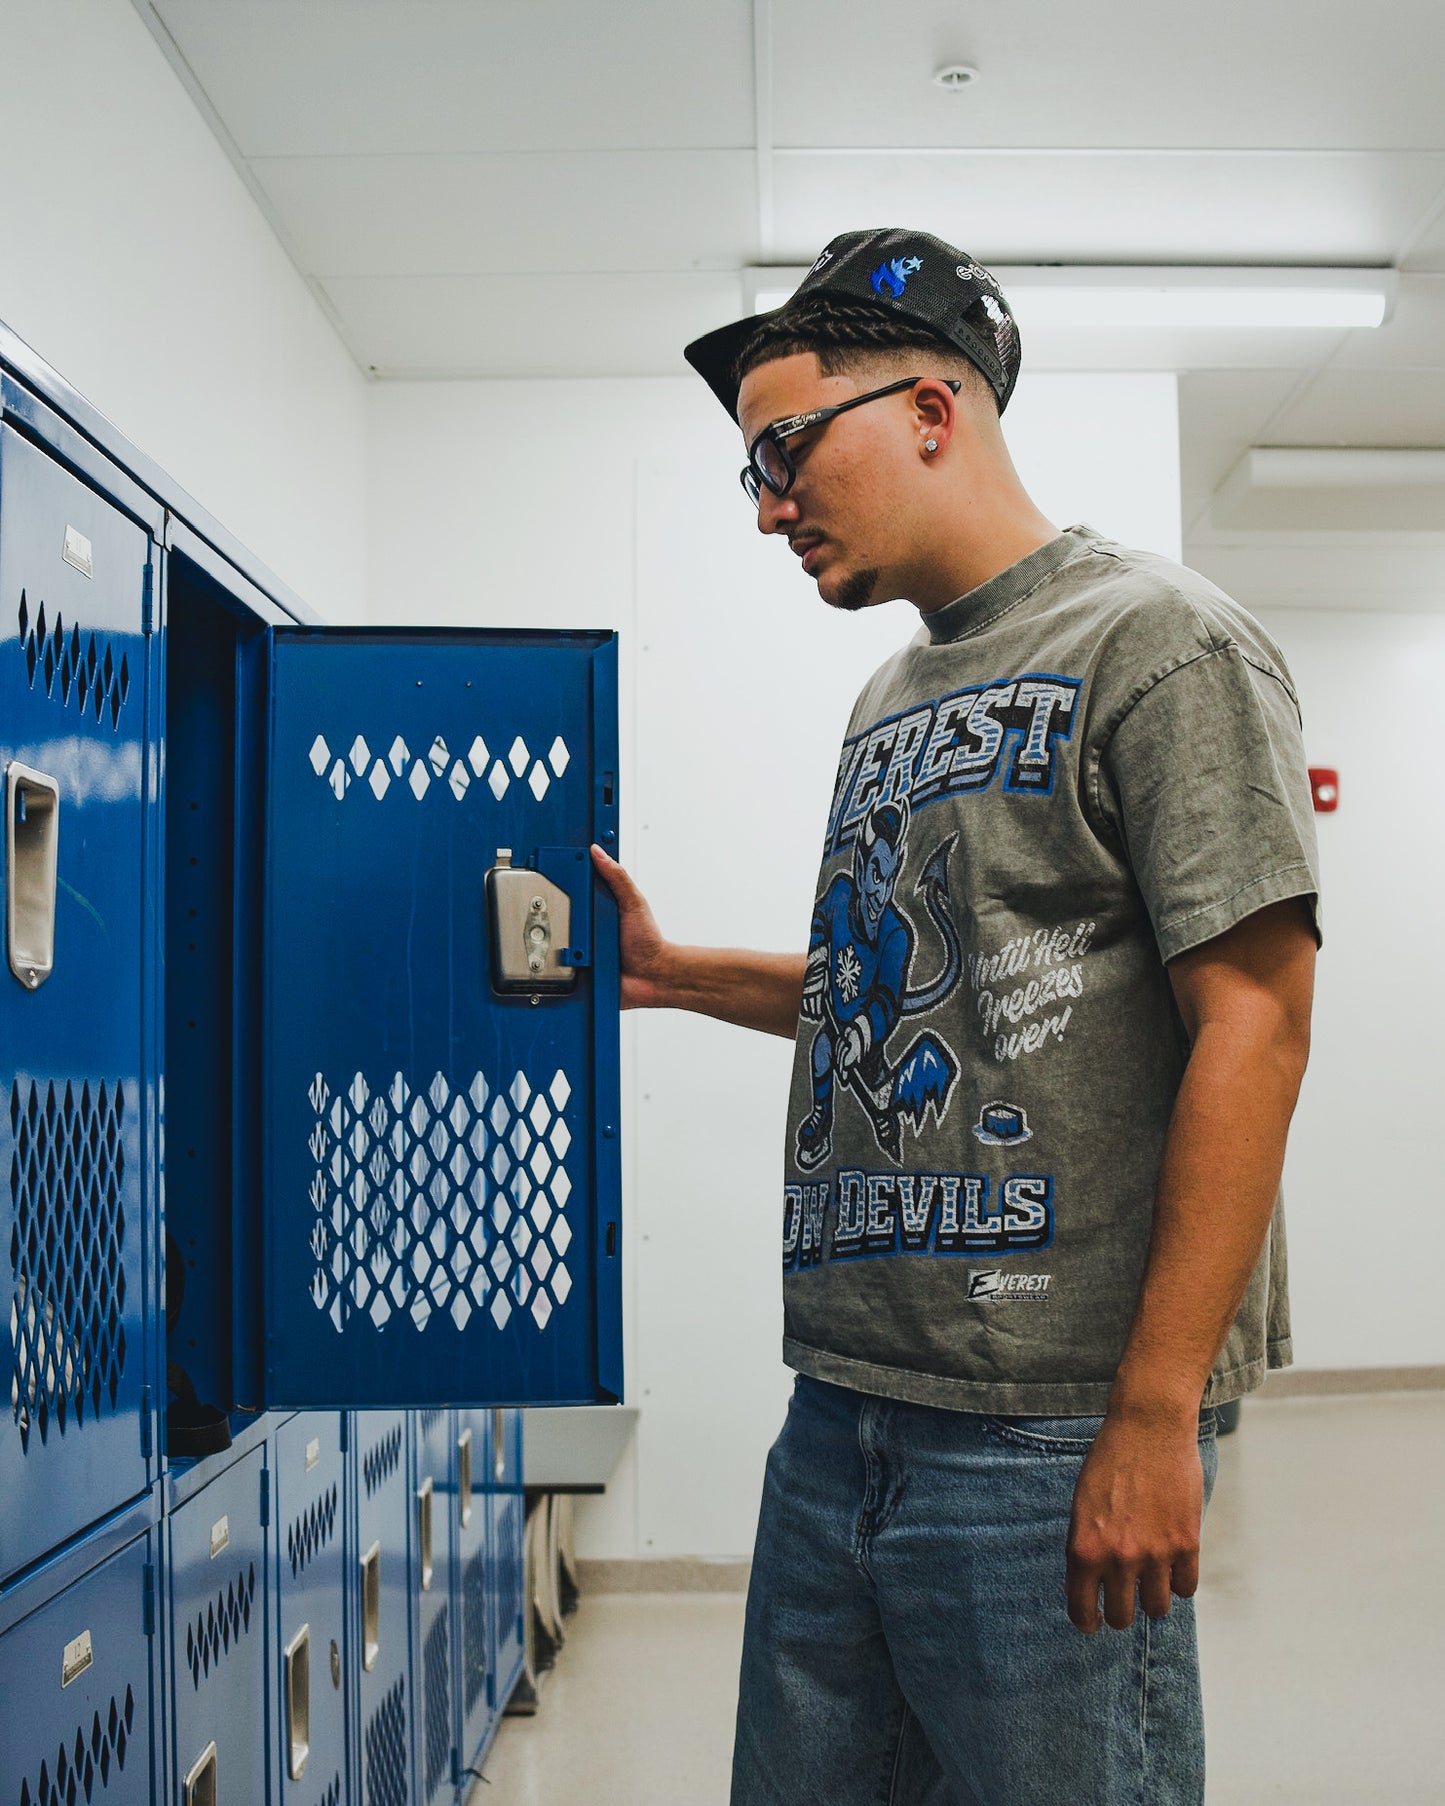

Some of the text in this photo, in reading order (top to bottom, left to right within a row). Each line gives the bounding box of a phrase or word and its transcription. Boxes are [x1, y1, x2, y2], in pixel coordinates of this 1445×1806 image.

[1032, 922, 1096, 966] Hell
[994, 1005, 1073, 1062] over!
[835, 1170, 1046, 1240] DEVILS
[965, 1270, 1051, 1300] EVEREST
